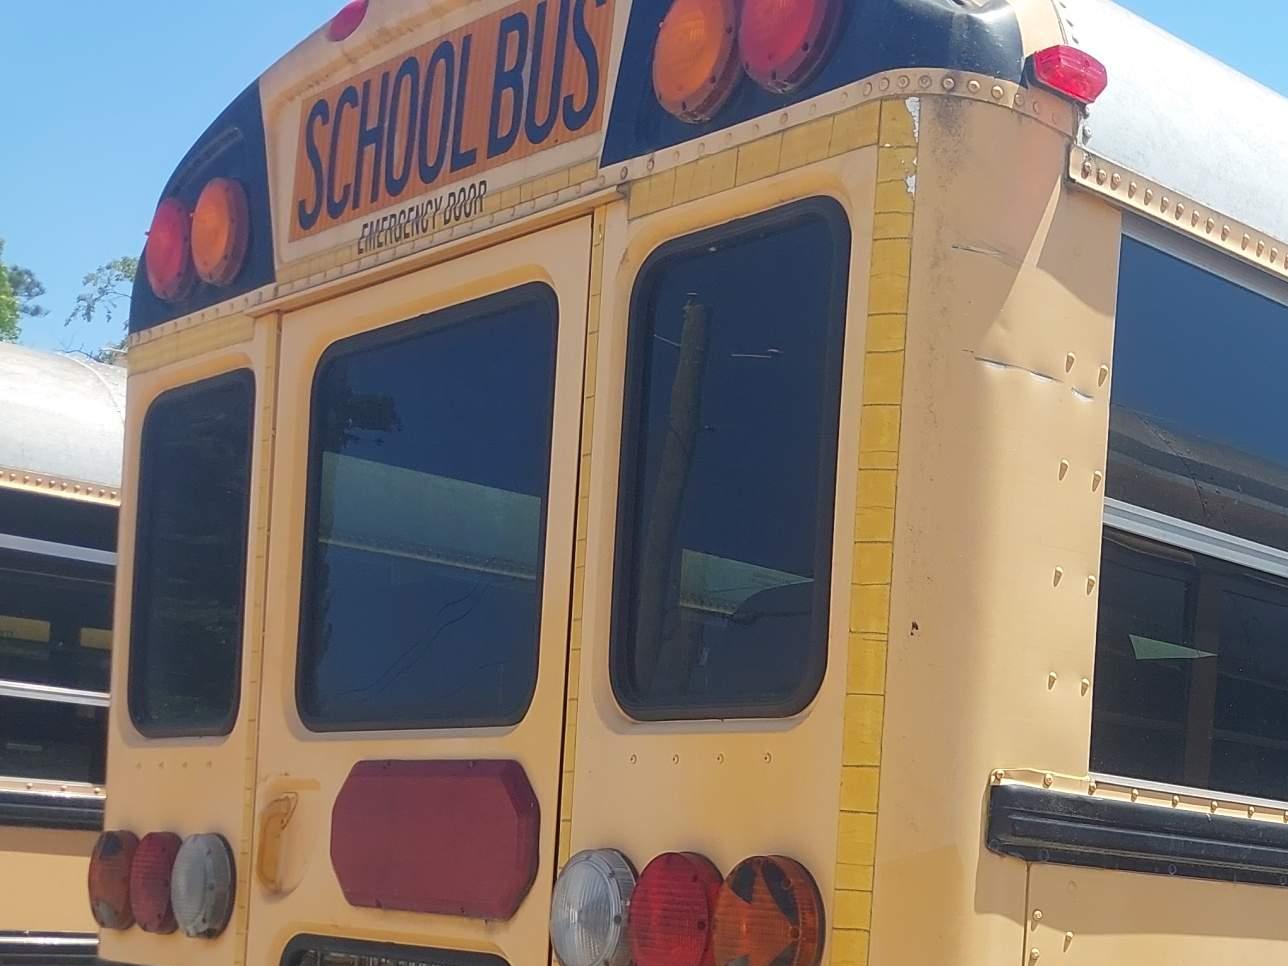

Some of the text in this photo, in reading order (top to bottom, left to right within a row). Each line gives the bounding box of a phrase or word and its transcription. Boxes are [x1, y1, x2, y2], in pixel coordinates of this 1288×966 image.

[297, 0, 606, 231] SCHOOL BUS
[357, 180, 488, 255] EMERGENCY DOOR
